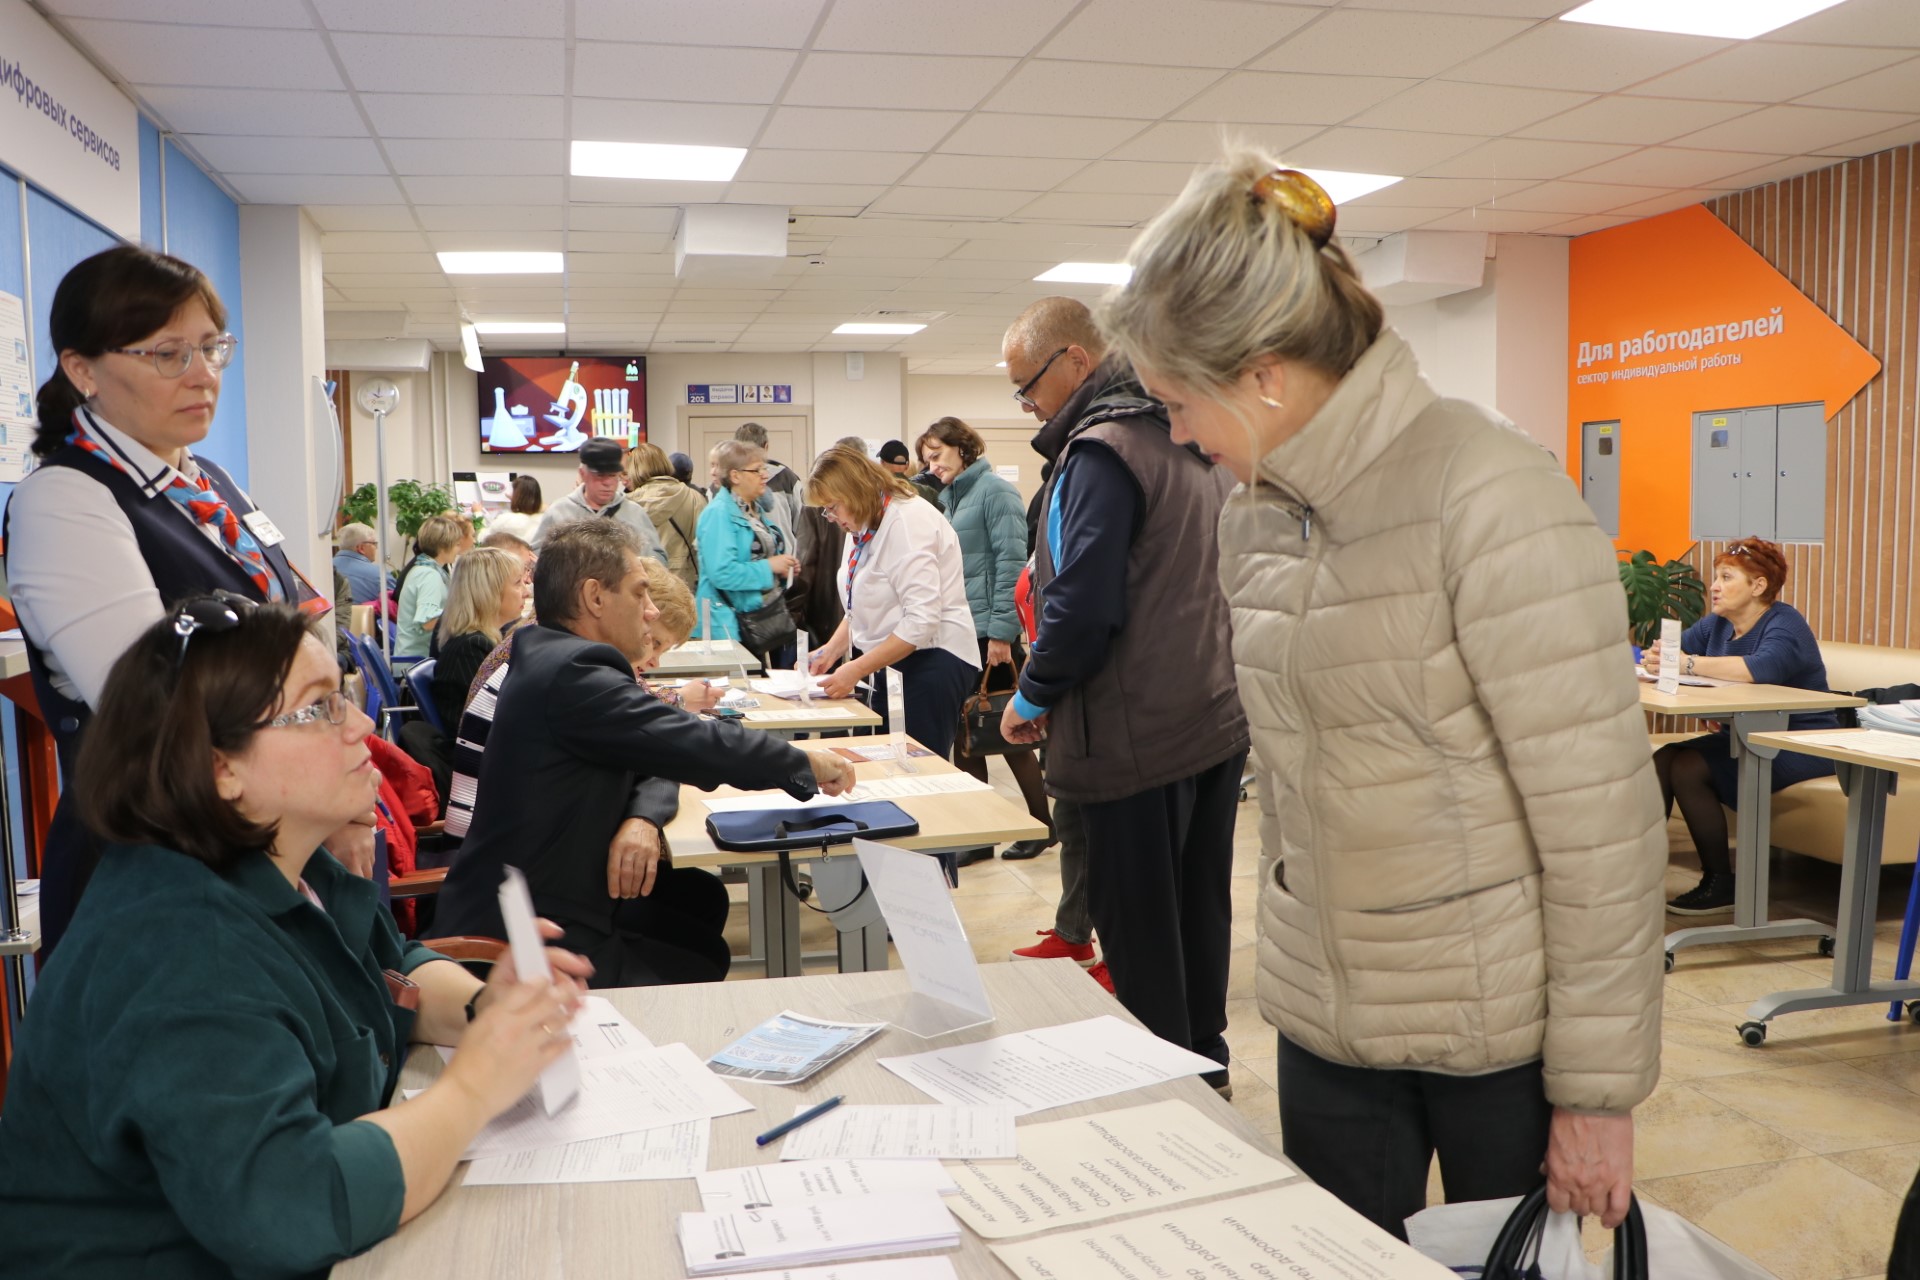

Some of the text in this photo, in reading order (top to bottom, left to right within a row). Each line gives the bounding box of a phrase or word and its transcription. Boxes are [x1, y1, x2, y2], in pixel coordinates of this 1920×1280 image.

[70, 114, 120, 171] сервисов
[1577, 307, 1784, 368] Для работодателей
[1577, 352, 1741, 384] сектор индивидуальной работы
[1086, 1120, 1186, 1192] Электрогазосварщик
[1033, 1171, 1086, 1213] Начальник
[1071, 1176, 1111, 1207] Слесарь
[1079, 1161, 1136, 1203] Тракторист
[1104, 1157, 1162, 1197] Экономист
[983, 1182, 1034, 1223] Машинист
[1016, 1183, 1060, 1218] Механик
[1161, 1222, 1221, 1262] рабочий
[1221, 1216, 1295, 1264] дорожный
